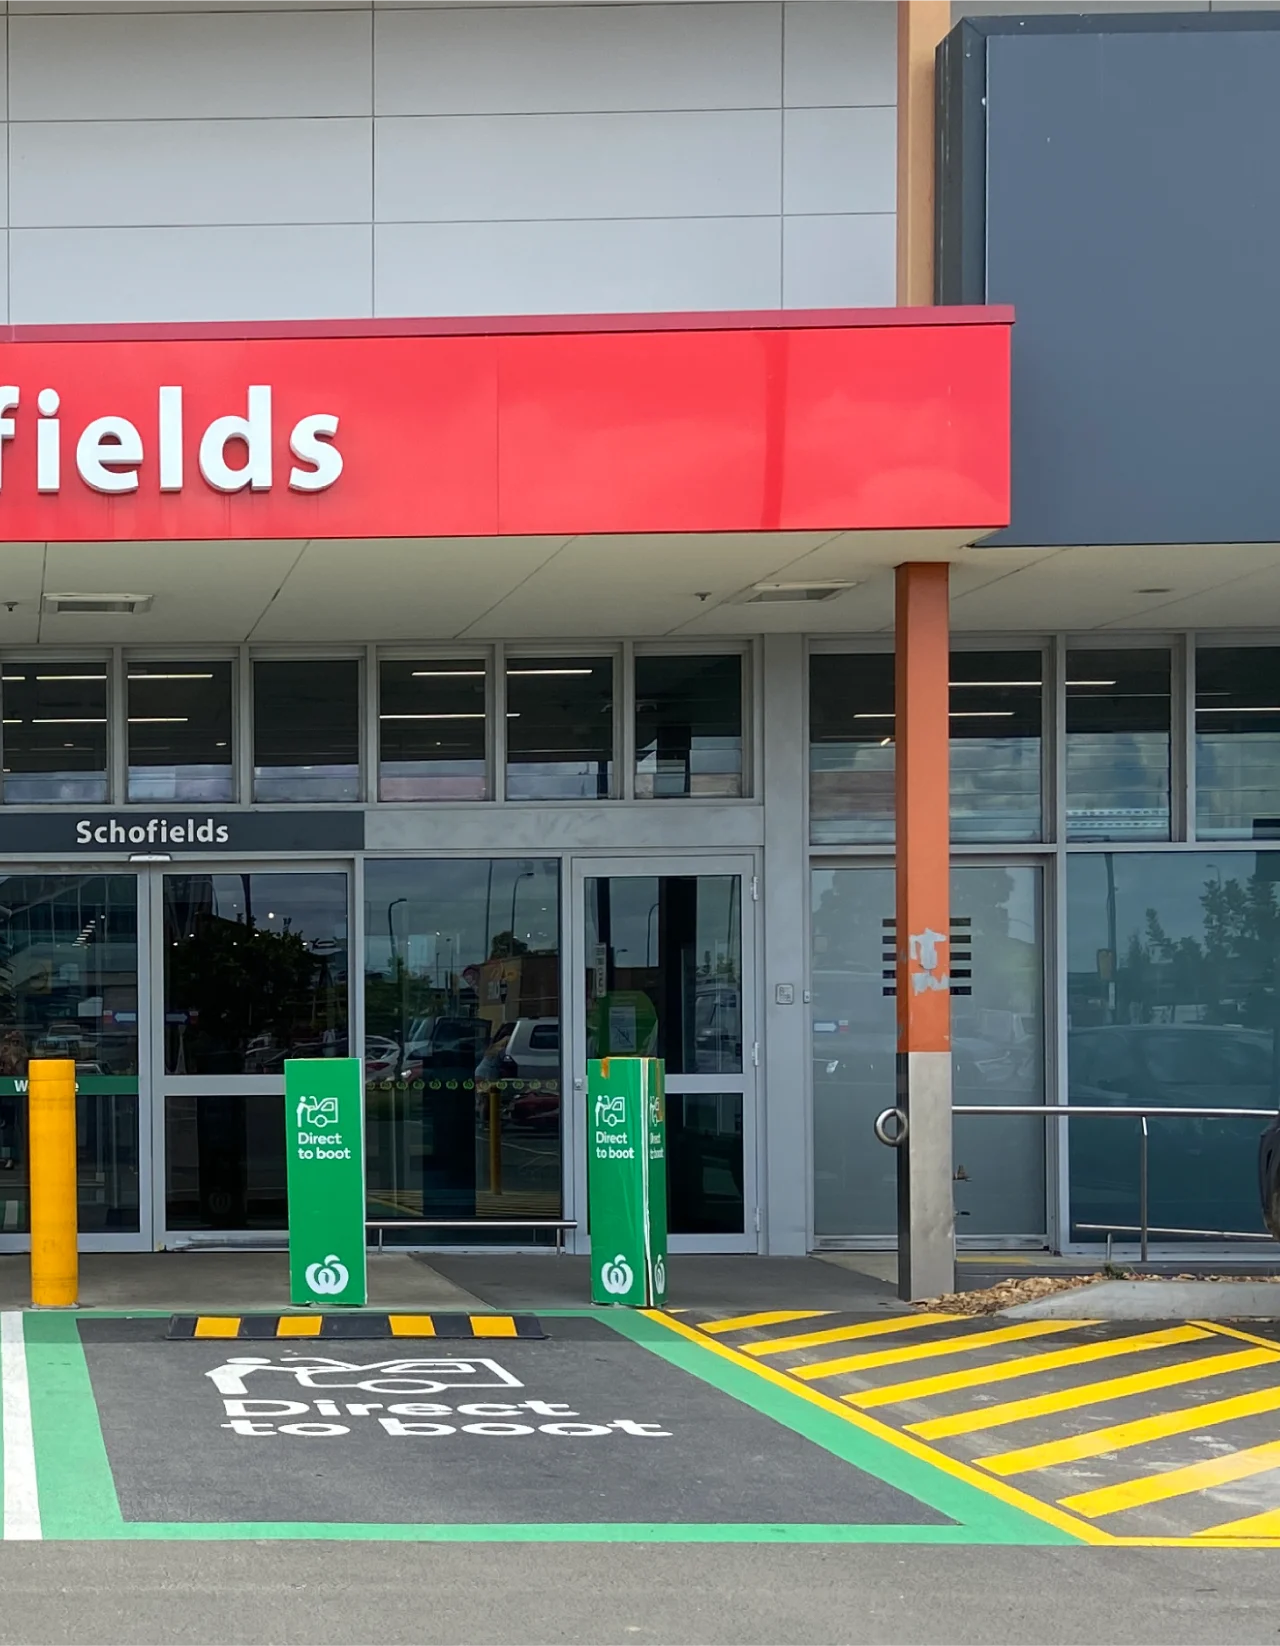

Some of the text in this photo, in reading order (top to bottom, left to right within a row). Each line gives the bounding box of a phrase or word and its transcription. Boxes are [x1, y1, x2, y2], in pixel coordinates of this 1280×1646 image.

[76, 819, 229, 843] Schofields
[298, 1131, 342, 1144] Direct
[596, 1131, 628, 1144] Direct
[297, 1147, 351, 1159] to boot
[596, 1146, 635, 1159] to boot
[222, 1399, 580, 1417] Direct
[221, 1417, 673, 1438] to boot
